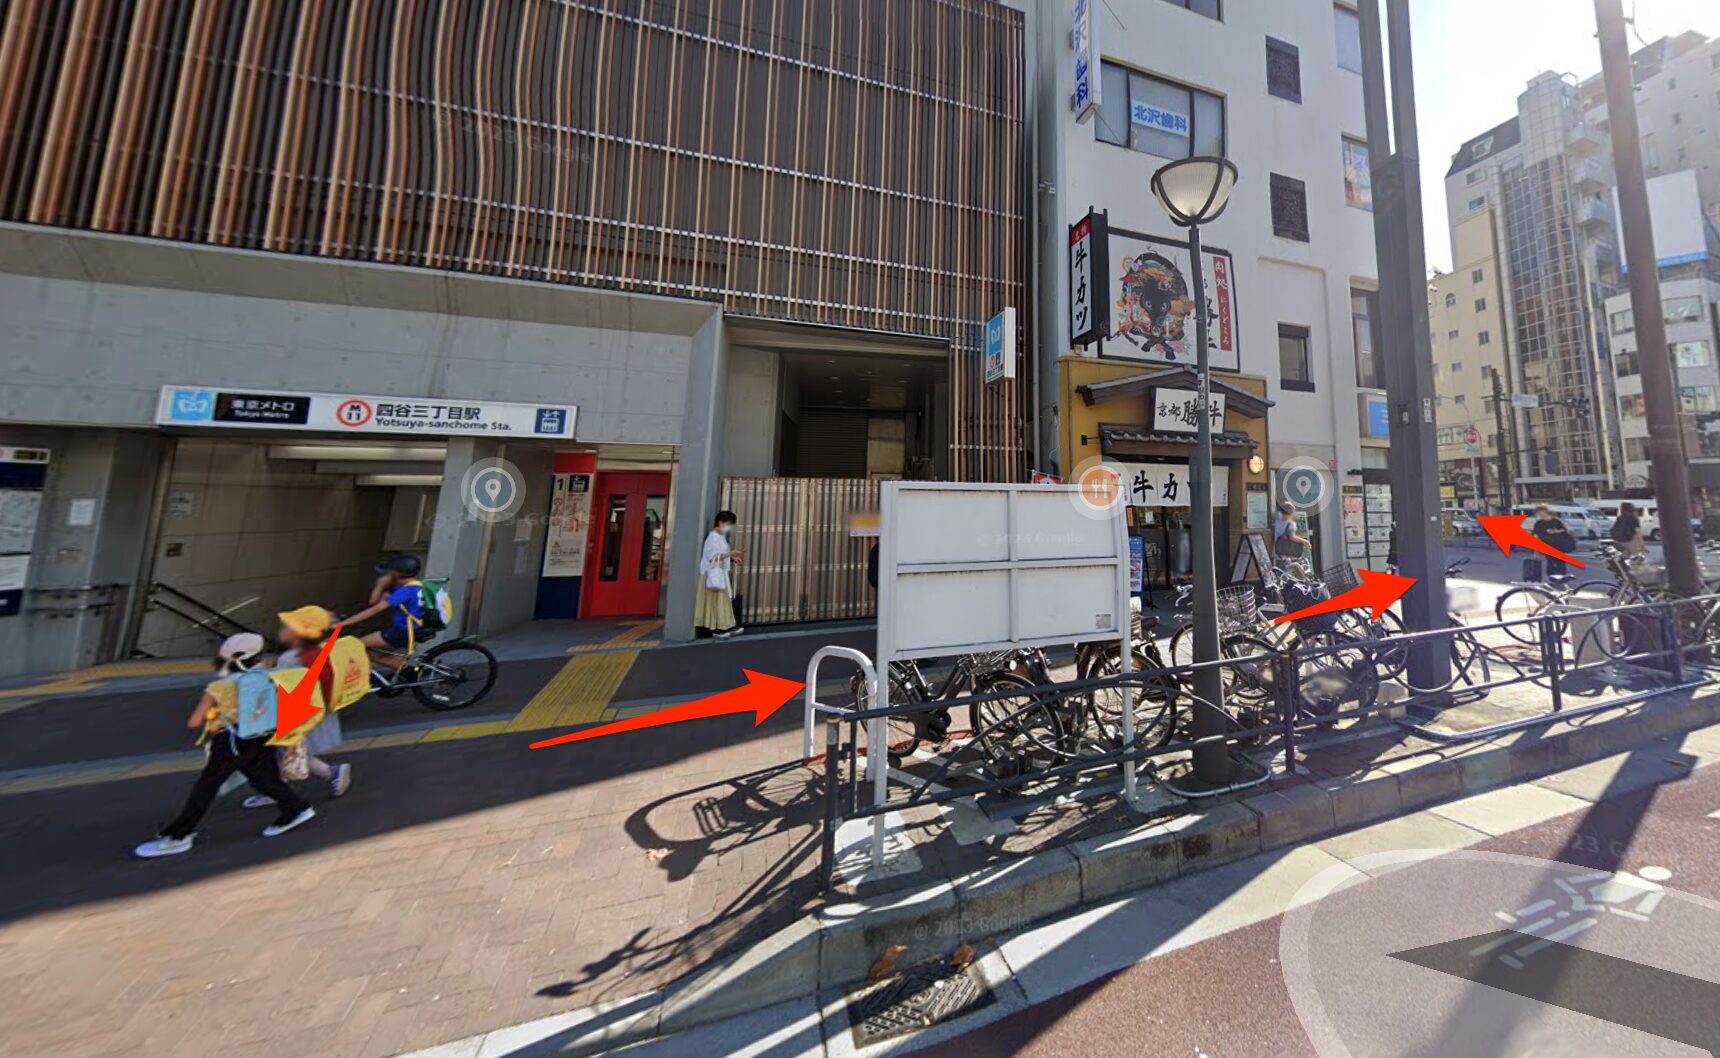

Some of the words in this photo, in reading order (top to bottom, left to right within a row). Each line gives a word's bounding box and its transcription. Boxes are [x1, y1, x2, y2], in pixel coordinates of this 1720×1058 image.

[1133, 104, 1187, 132] 北沢歯科
[1215, 261, 1228, 290] 肉処
[1075, 240, 1088, 331] 牛カツ
[231, 399, 295, 411] 東京メトロ
[349, 404, 361, 412] M
[376, 403, 481, 420] 四谷三丁目駅
[234, 409, 262, 418] Tokyo
[263, 411, 291, 419] Metro
[347, 412, 361, 421] 11
[375, 418, 488, 430] Yotsuya-sanchome
[490, 421, 512, 431] Sta.
[557, 478, 564, 491] 1
[1133, 470, 1191, 503] 牛カ
